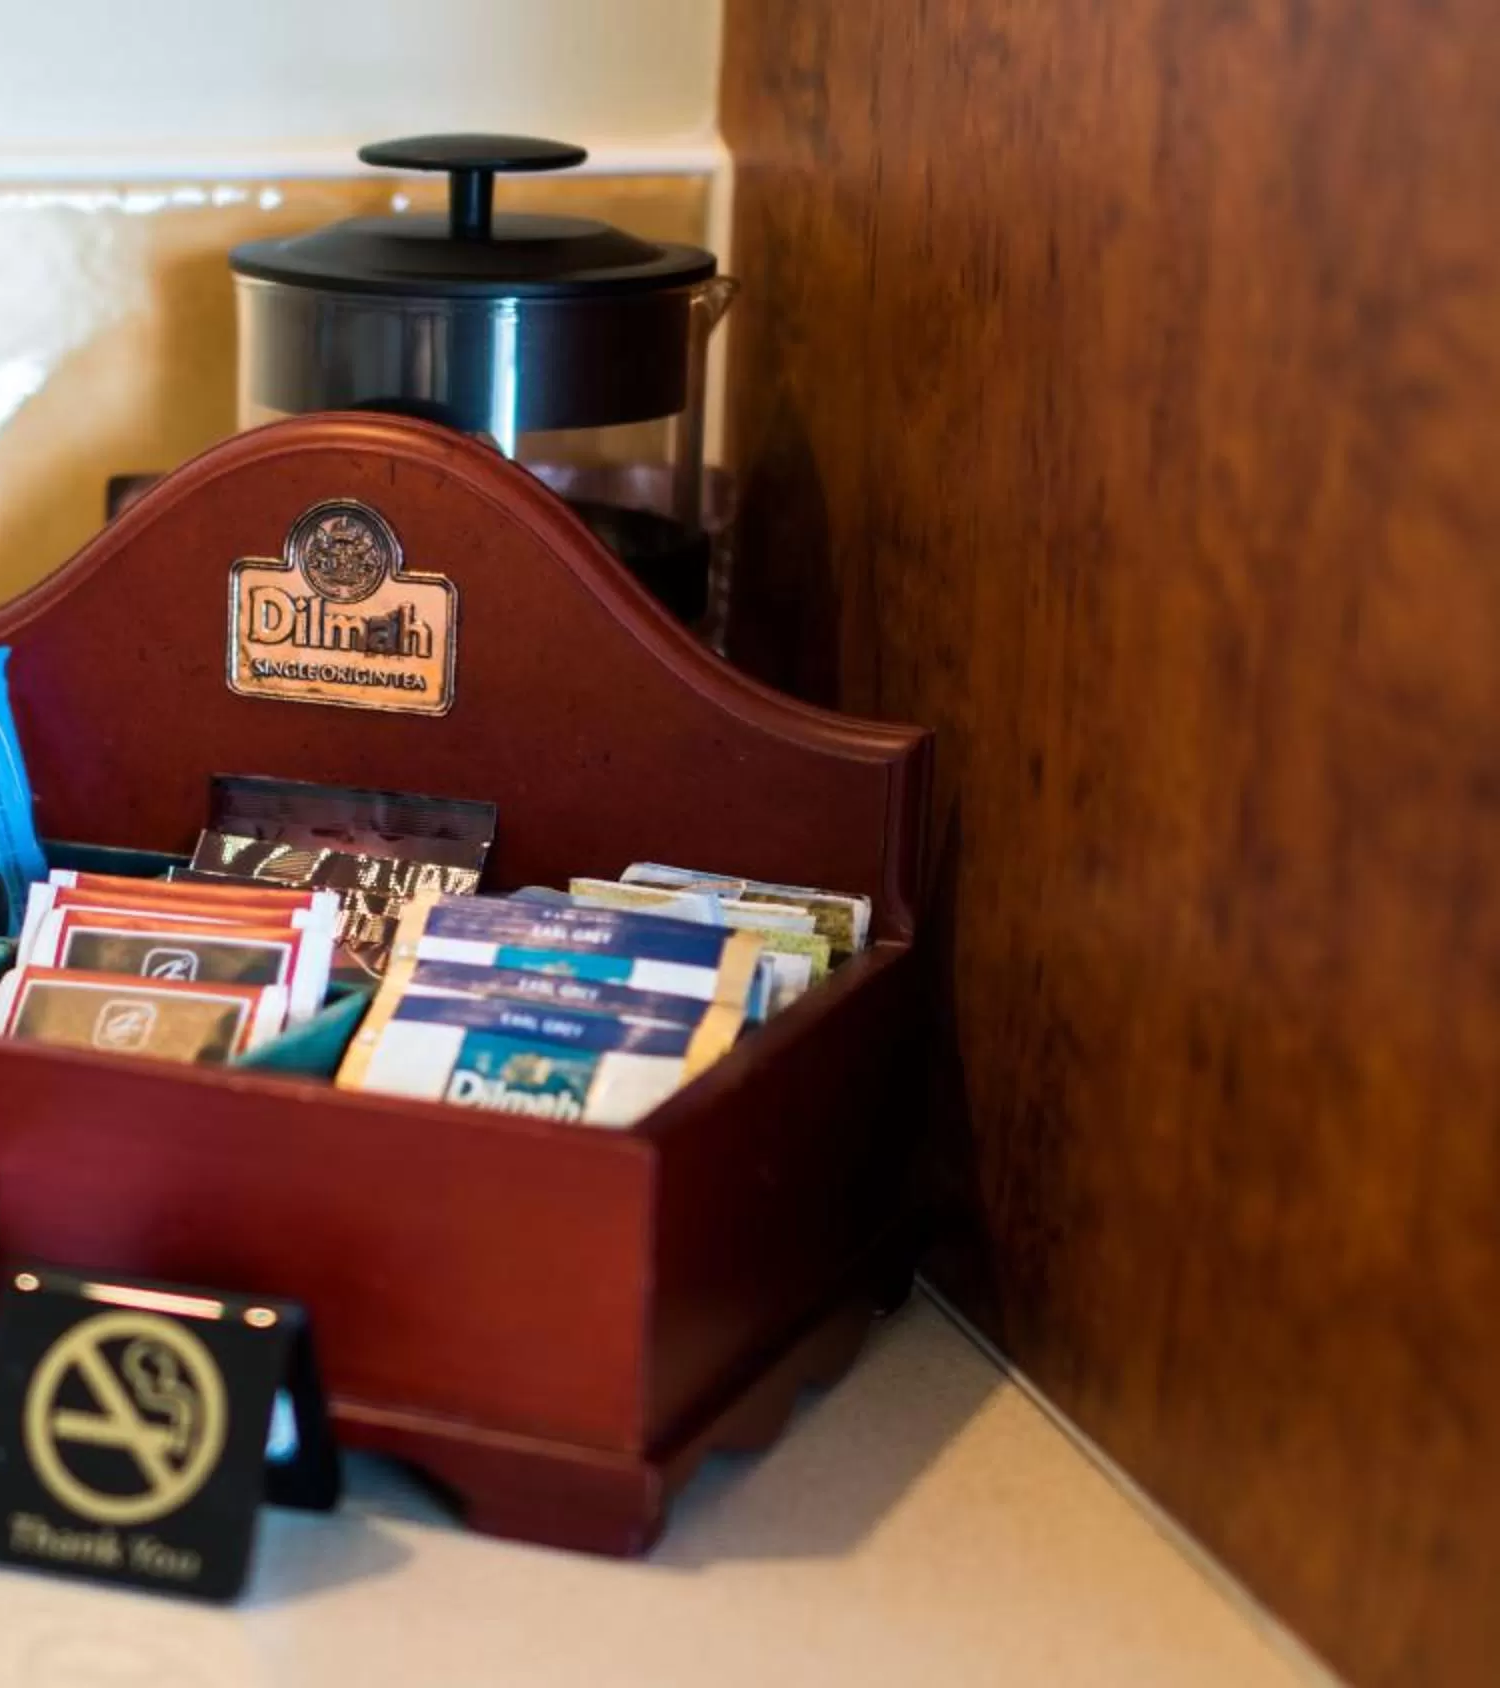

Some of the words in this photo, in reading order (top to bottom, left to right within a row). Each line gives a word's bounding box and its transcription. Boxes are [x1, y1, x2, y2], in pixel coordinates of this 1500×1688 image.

[249, 586, 433, 658] Dilmah
[251, 657, 320, 683] SINGLE
[320, 664, 389, 687] ORIGIN
[388, 671, 428, 692] TEA
[500, 1011, 540, 1032] EARL
[540, 1018, 585, 1039] GREY
[447, 1068, 583, 1125] Dilmah
[8, 1512, 124, 1569] Thank
[127, 1532, 201, 1581] You
